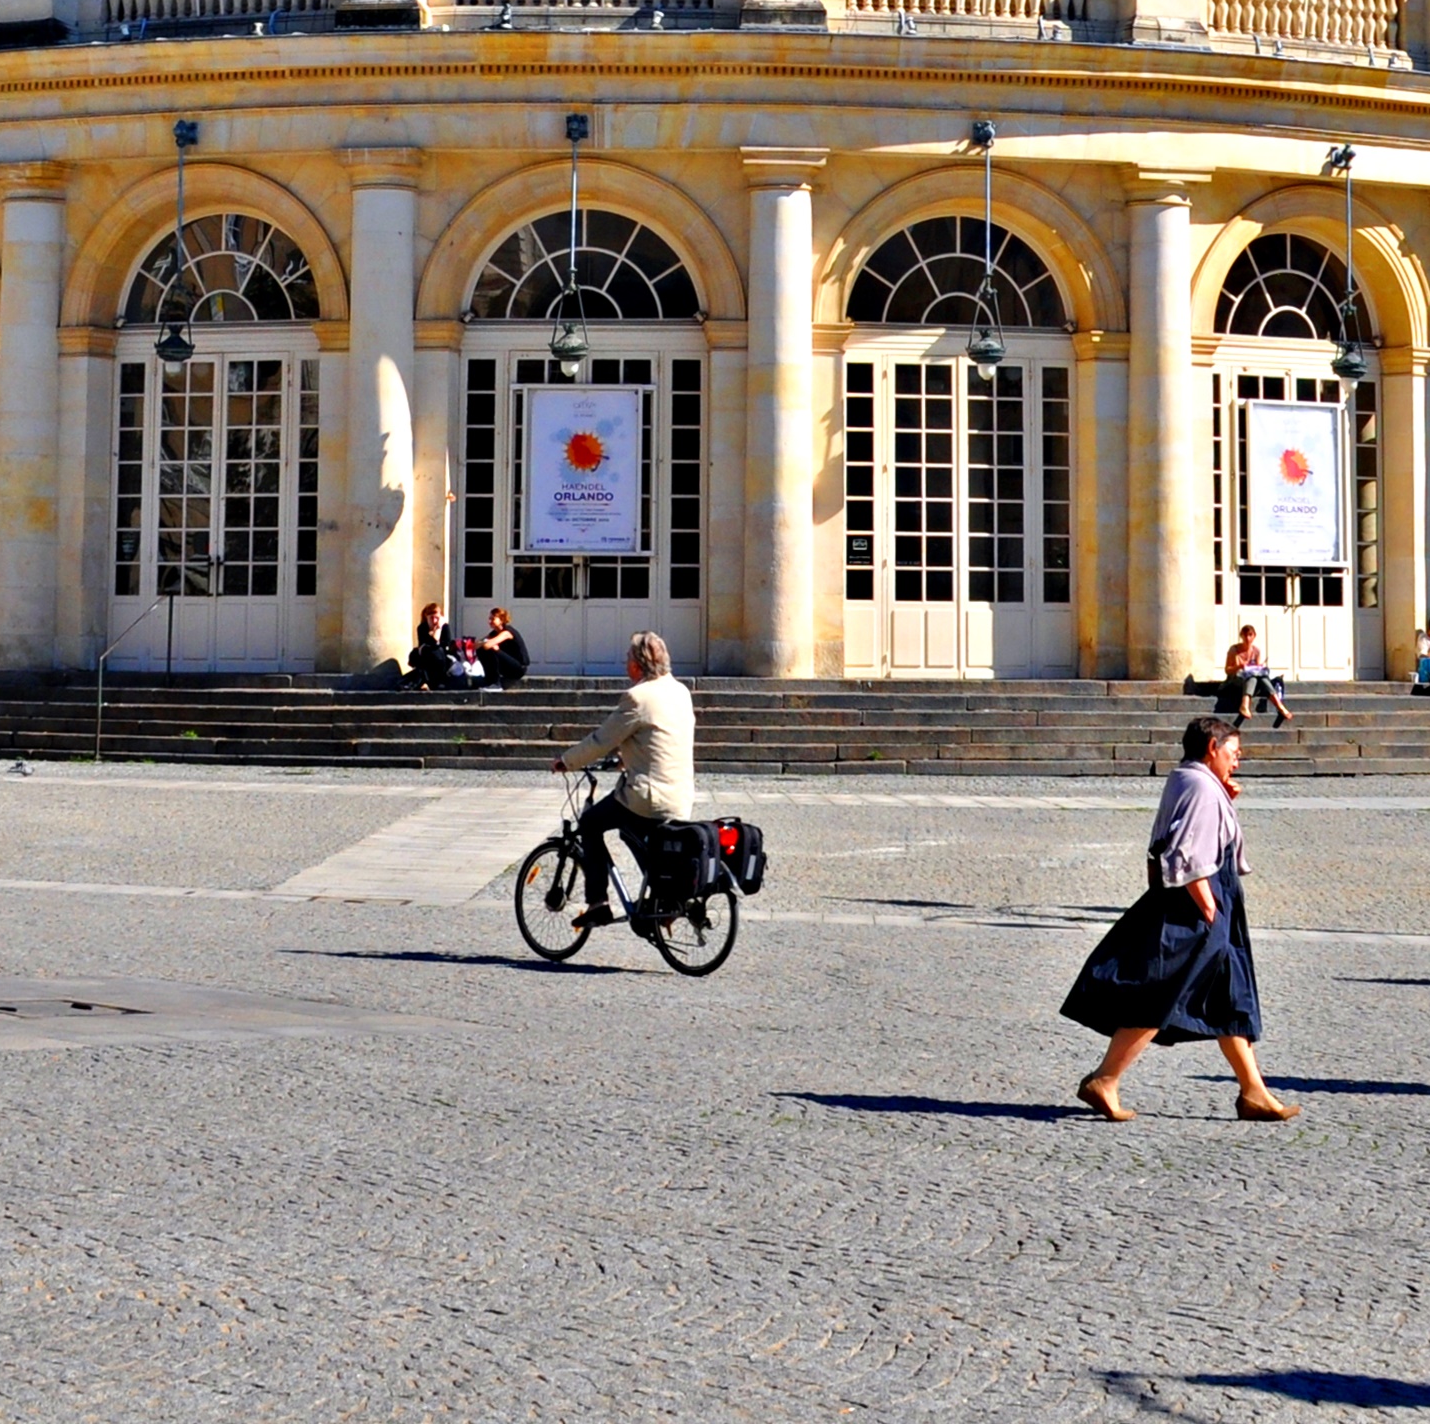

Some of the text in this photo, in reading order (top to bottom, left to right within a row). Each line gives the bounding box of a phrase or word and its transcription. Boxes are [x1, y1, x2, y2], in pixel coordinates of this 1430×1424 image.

[562, 483, 606, 491] HAENDEL
[554, 492, 614, 501] ORLANDO
[1272, 505, 1317, 514] ORLANDO
